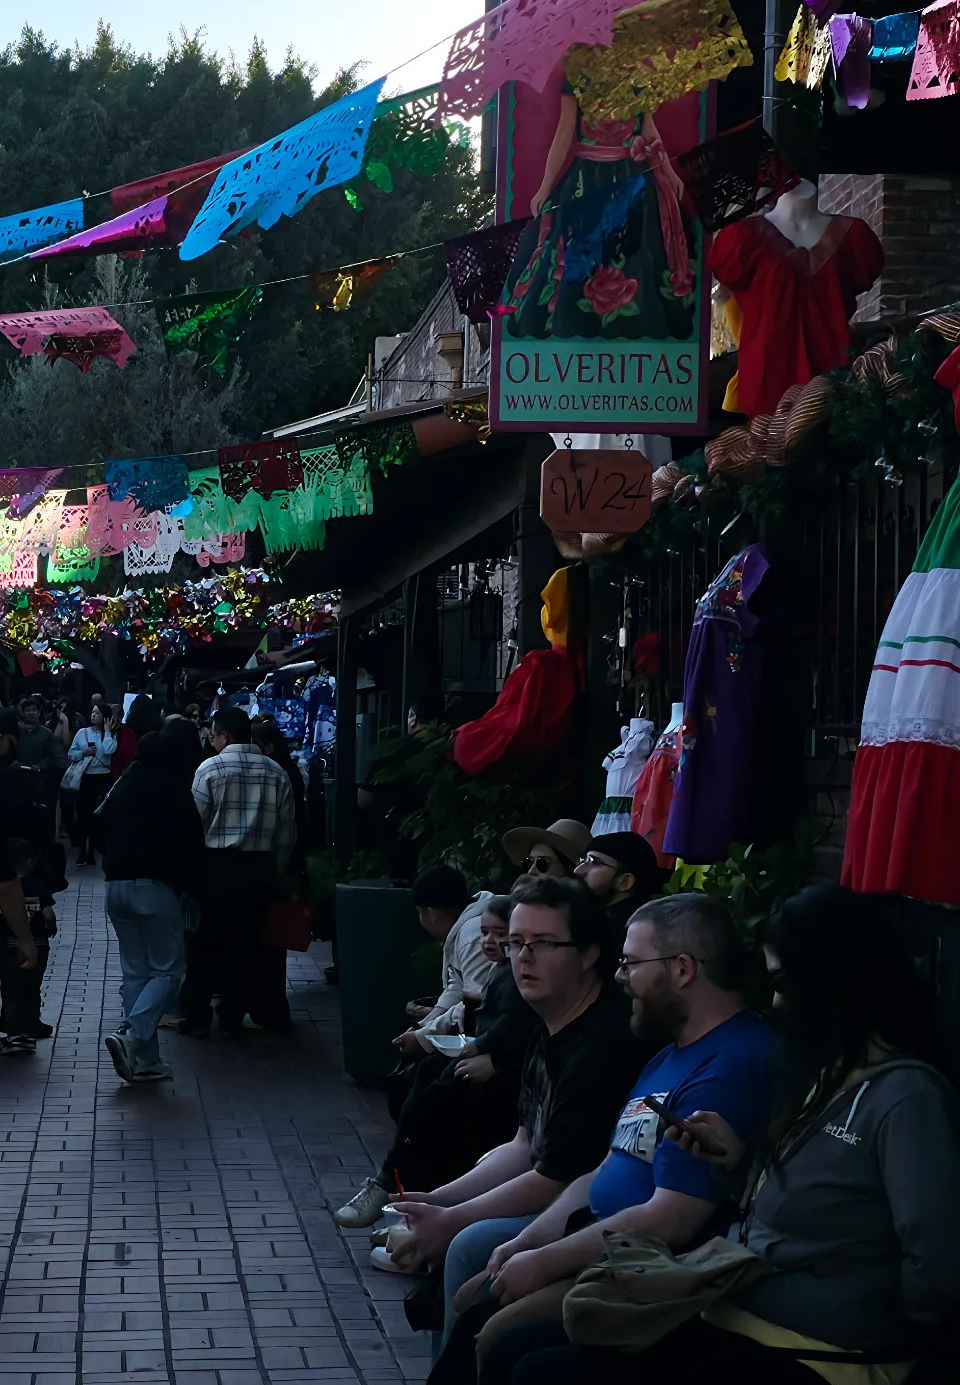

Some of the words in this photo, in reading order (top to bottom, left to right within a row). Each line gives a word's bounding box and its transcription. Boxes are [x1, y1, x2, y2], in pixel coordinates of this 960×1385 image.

[505, 352, 693, 385] OLVERITAS
[504, 394, 693, 412] WWW.OLVERITAS.COM
[551, 467, 599, 514] W
[602, 472, 648, 512] 24
